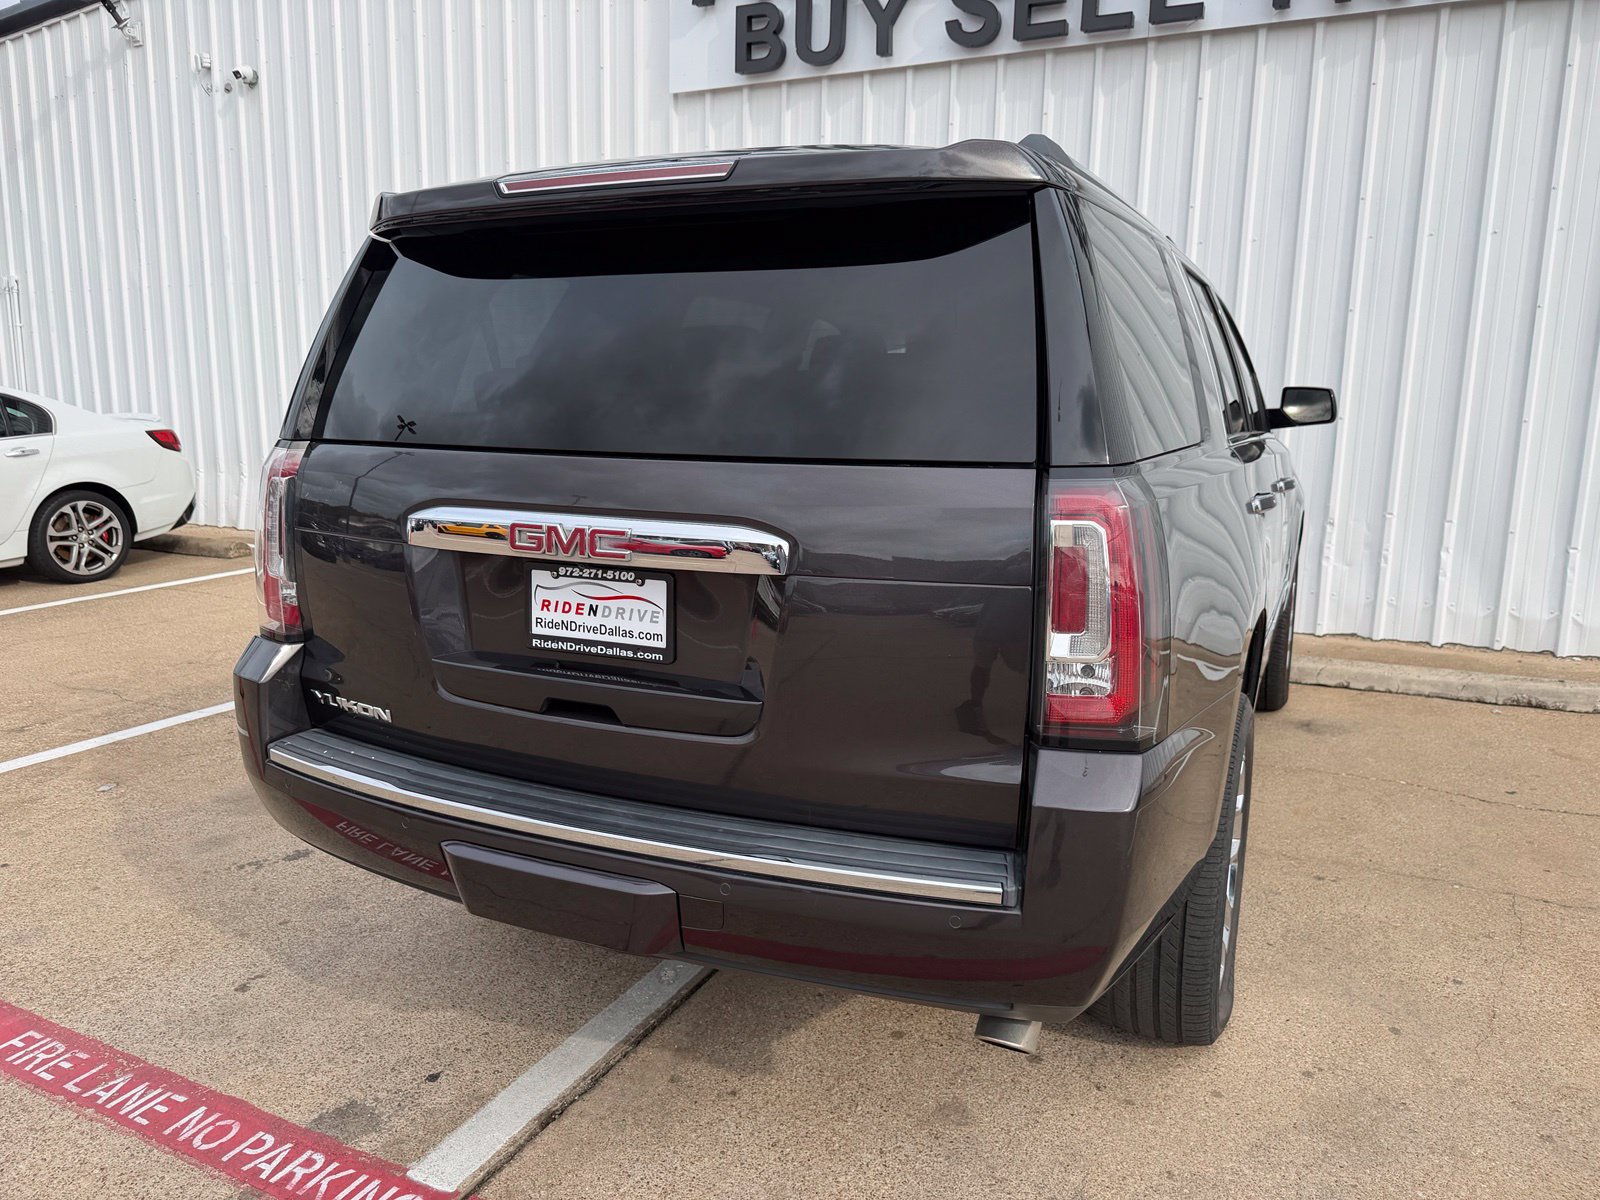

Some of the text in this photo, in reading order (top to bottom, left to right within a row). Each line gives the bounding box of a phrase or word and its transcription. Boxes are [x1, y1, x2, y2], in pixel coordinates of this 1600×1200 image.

[735, 0, 907, 75] BUY
[509, 522, 633, 562] GMC
[558, 566, 636, 581] 972-271-5100
[540, 599, 661, 625] RIDENDRIVE
[535, 617, 664, 643] RideNDriveDallas.com
[532, 638, 664, 661] RideNDriveDallas.com
[310, 688, 393, 724] YUKON
[0, 1029, 424, 1200] FIRE LANE NO PARKIN
